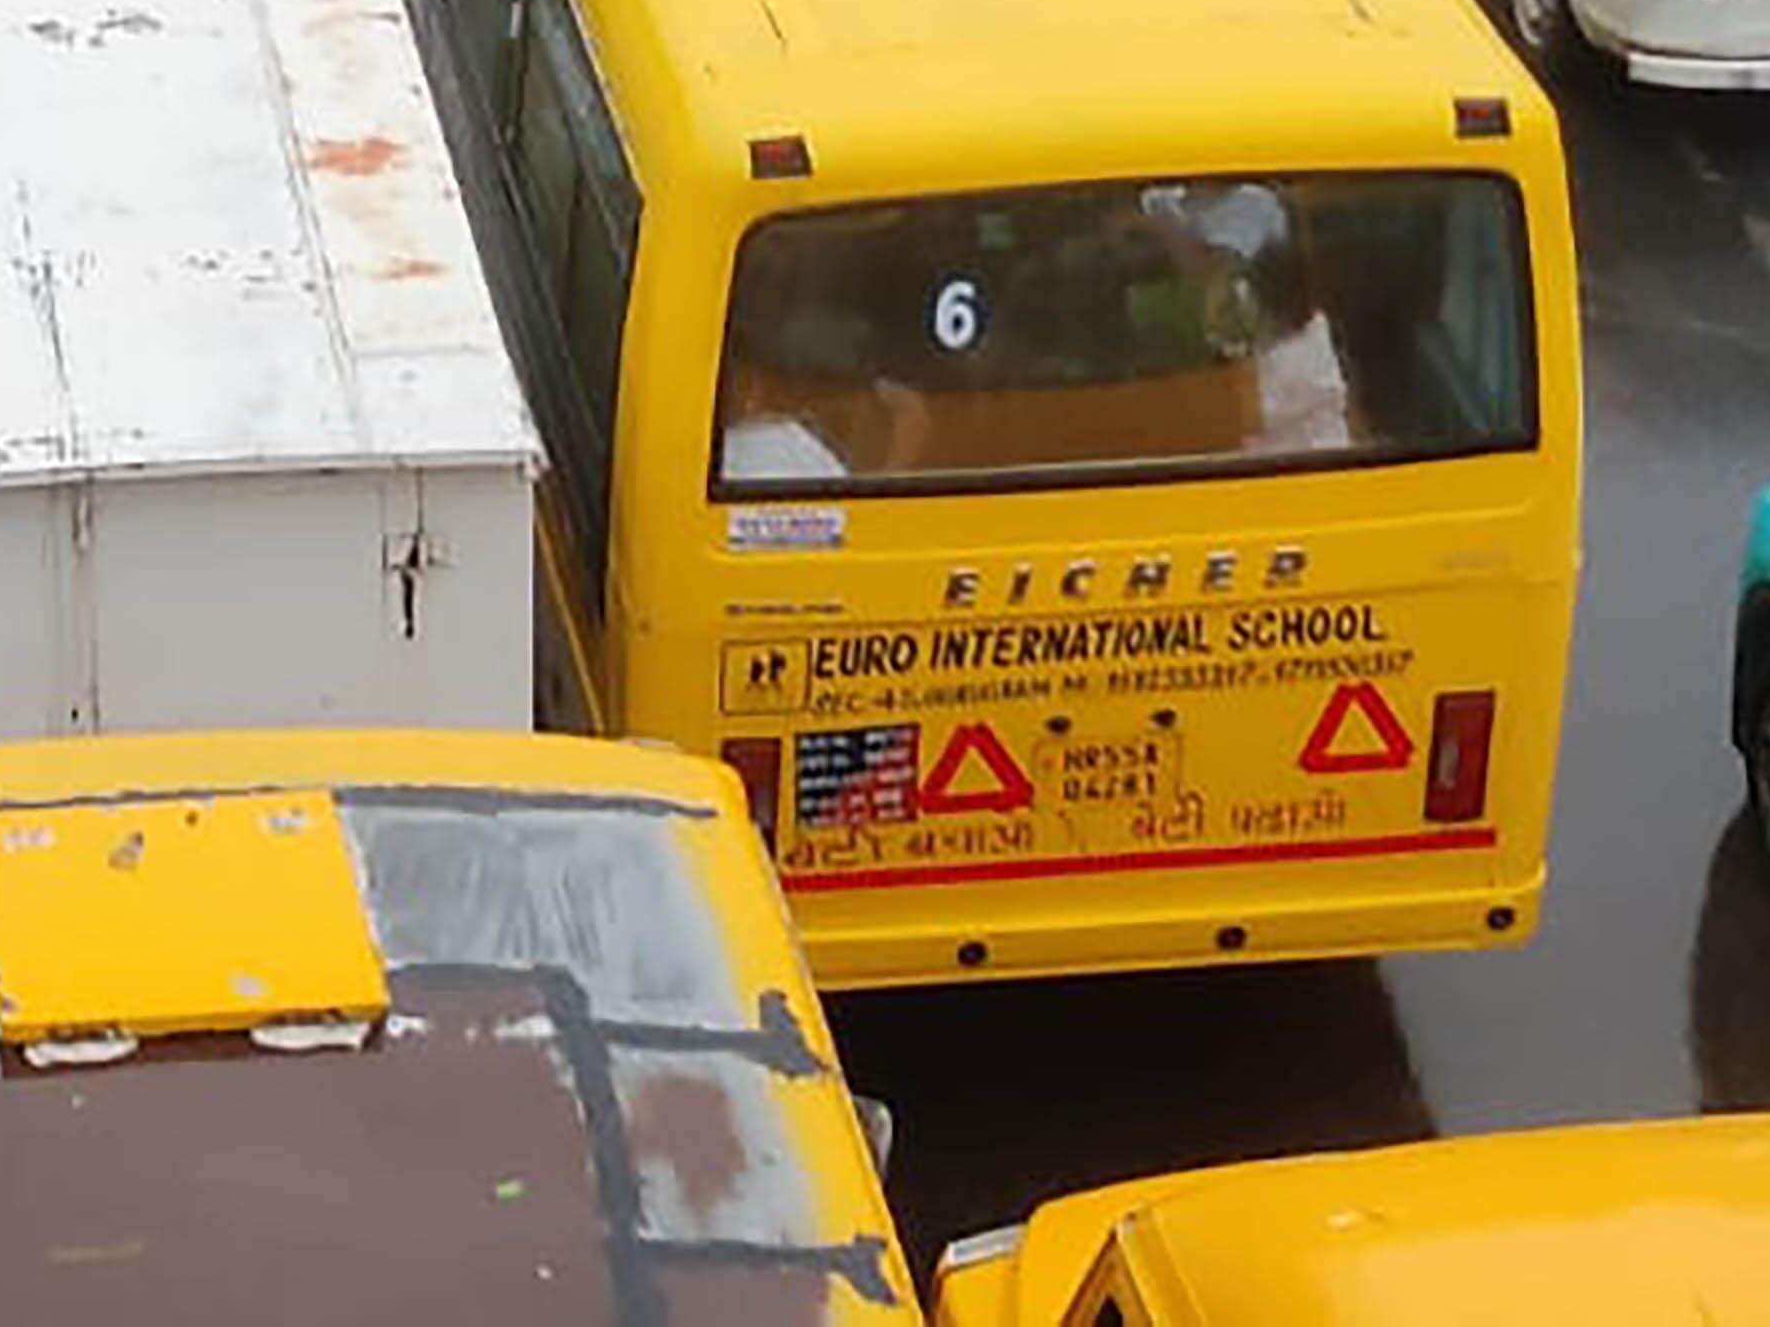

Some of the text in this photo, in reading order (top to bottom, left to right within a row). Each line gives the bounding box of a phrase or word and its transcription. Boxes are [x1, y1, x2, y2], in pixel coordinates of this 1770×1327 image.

[933, 282, 975, 347] 6
[945, 546, 1307, 608] EICHER
[813, 634, 919, 679] EURO
[928, 613, 1212, 671] INTERNATIONAL
[1227, 605, 1388, 651] SCHOOL
